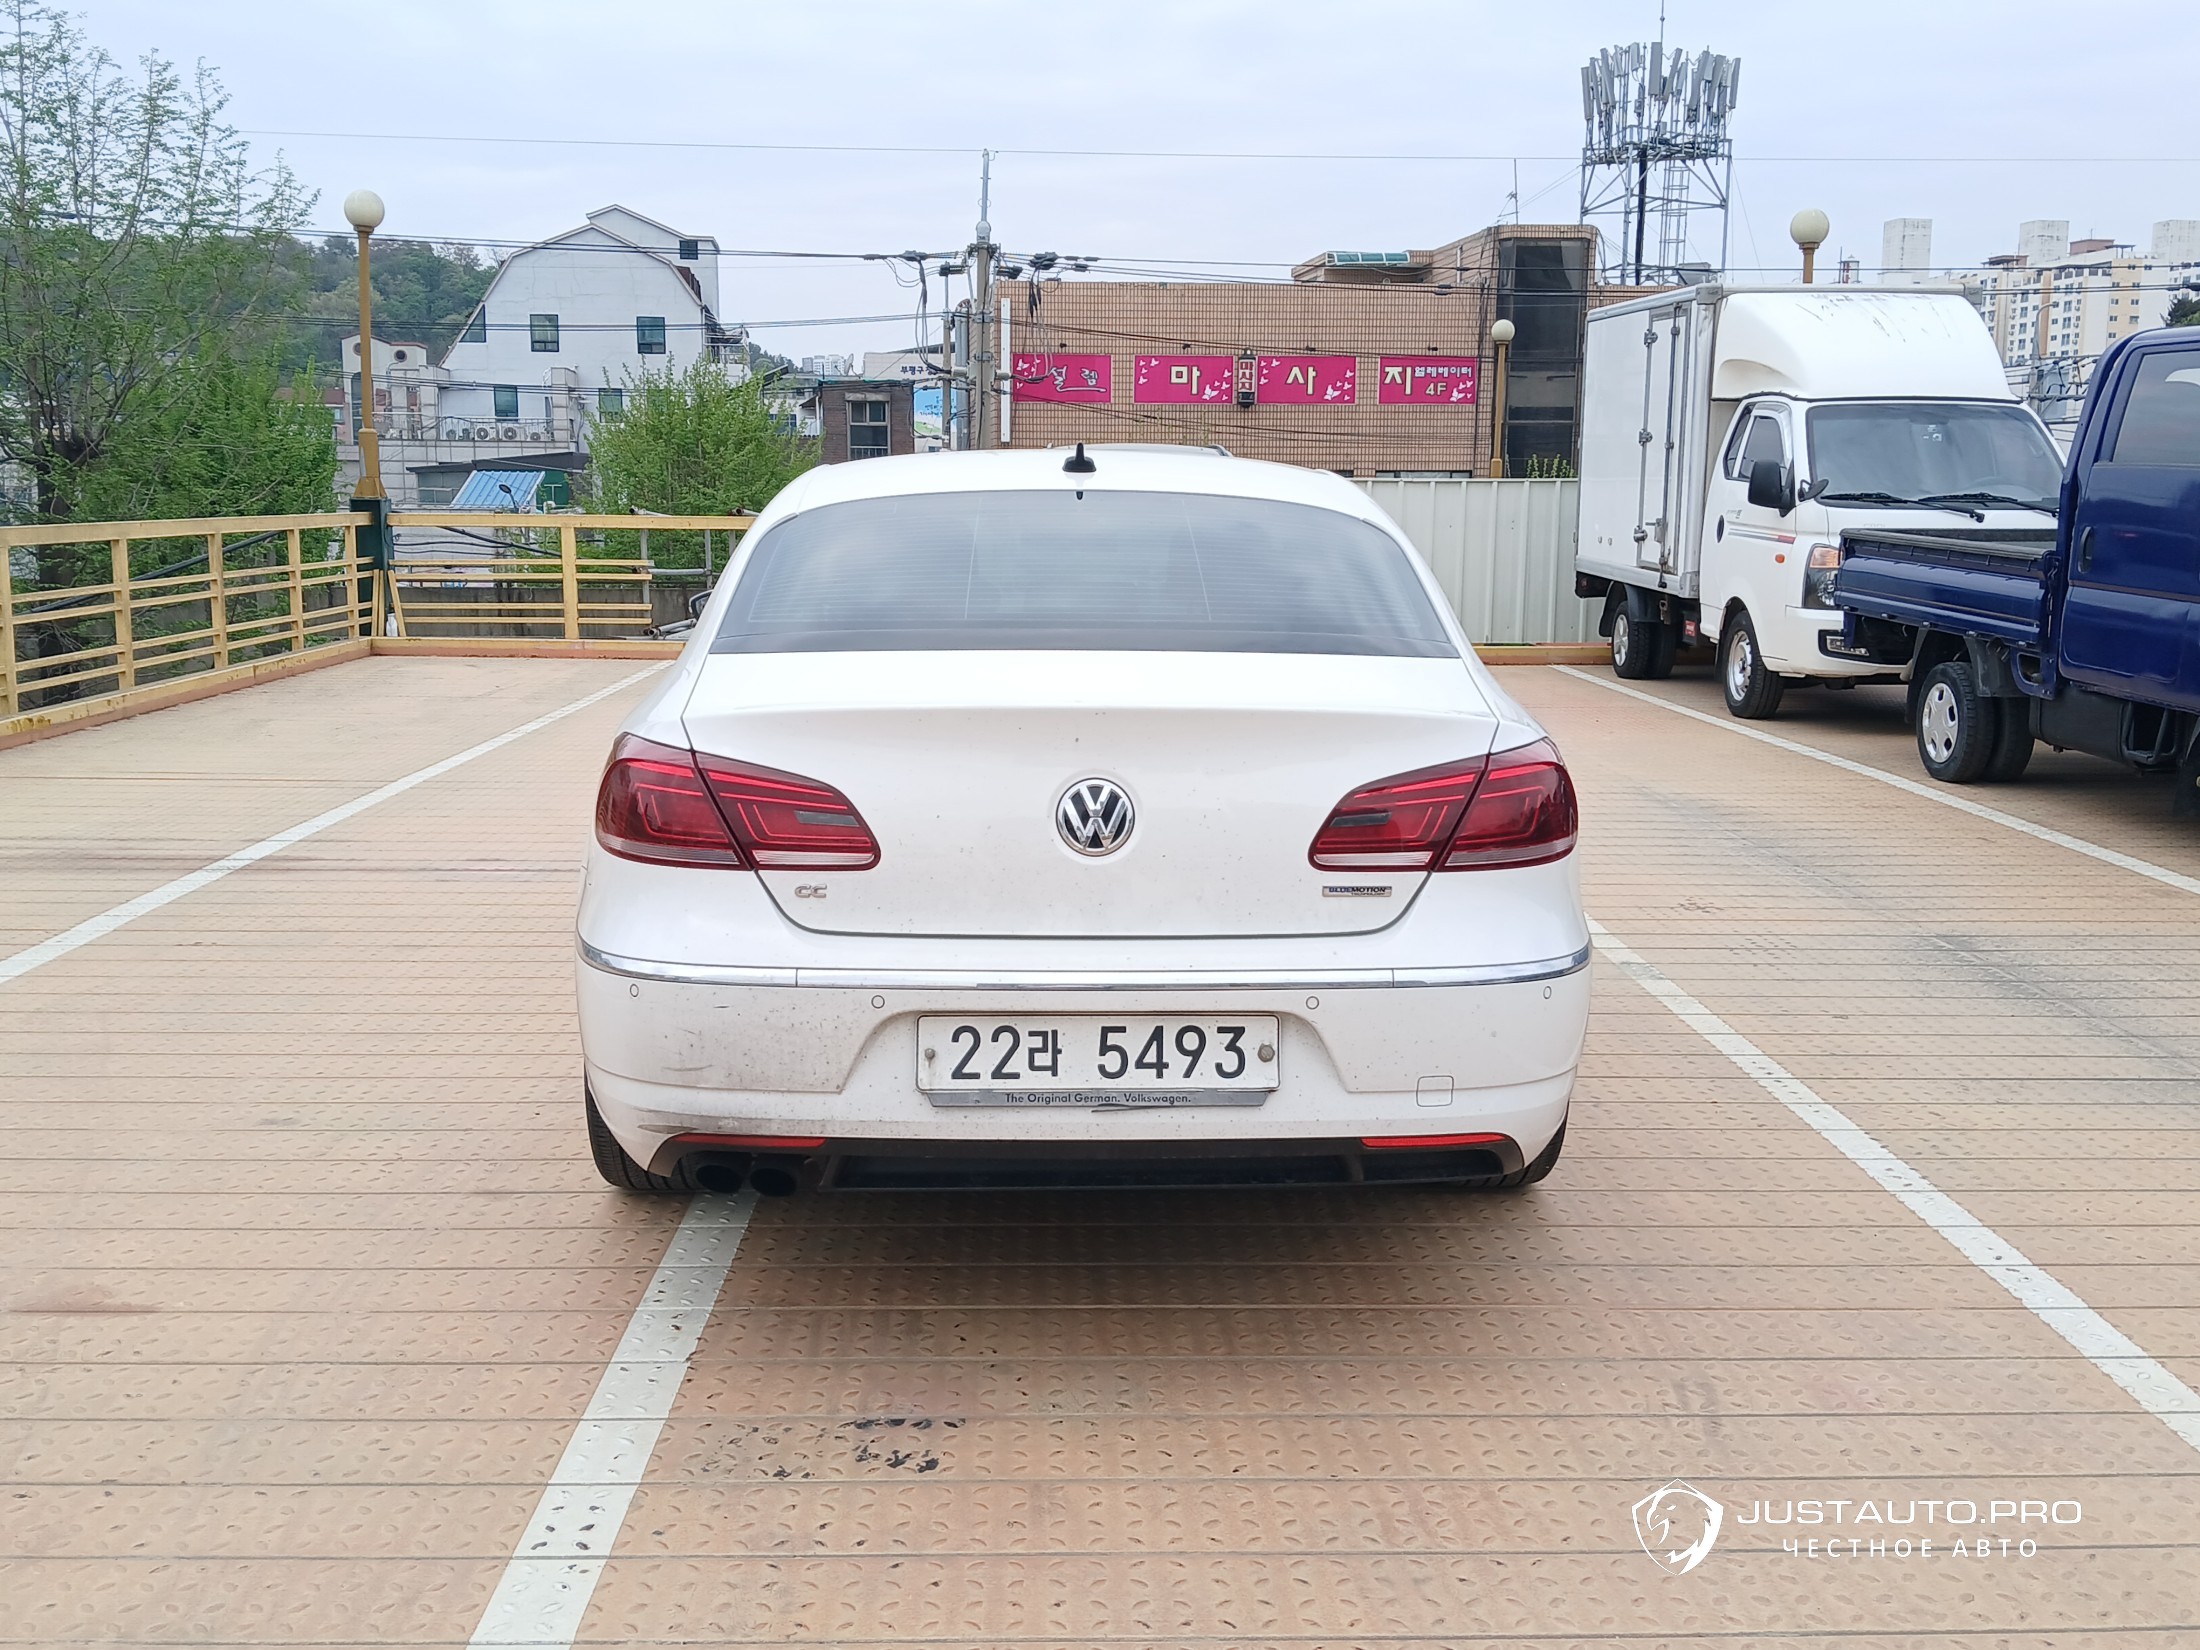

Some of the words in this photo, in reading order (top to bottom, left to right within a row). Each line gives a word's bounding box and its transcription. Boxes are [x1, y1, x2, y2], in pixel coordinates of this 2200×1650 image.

[1170, 365, 1200, 395] 마
[1286, 365, 1316, 396] 사
[1383, 366, 1412, 395] 지
[1425, 382, 1447, 396] 4F
[950, 1025, 1063, 1080] 22라
[1097, 1025, 1246, 1080] 5493
[1005, 1092, 1023, 1104] The
[1027, 1092, 1071, 1105] Original
[1074, 1092, 1120, 1104] German.
[1123, 1092, 1191, 1106] Volkswagen.
